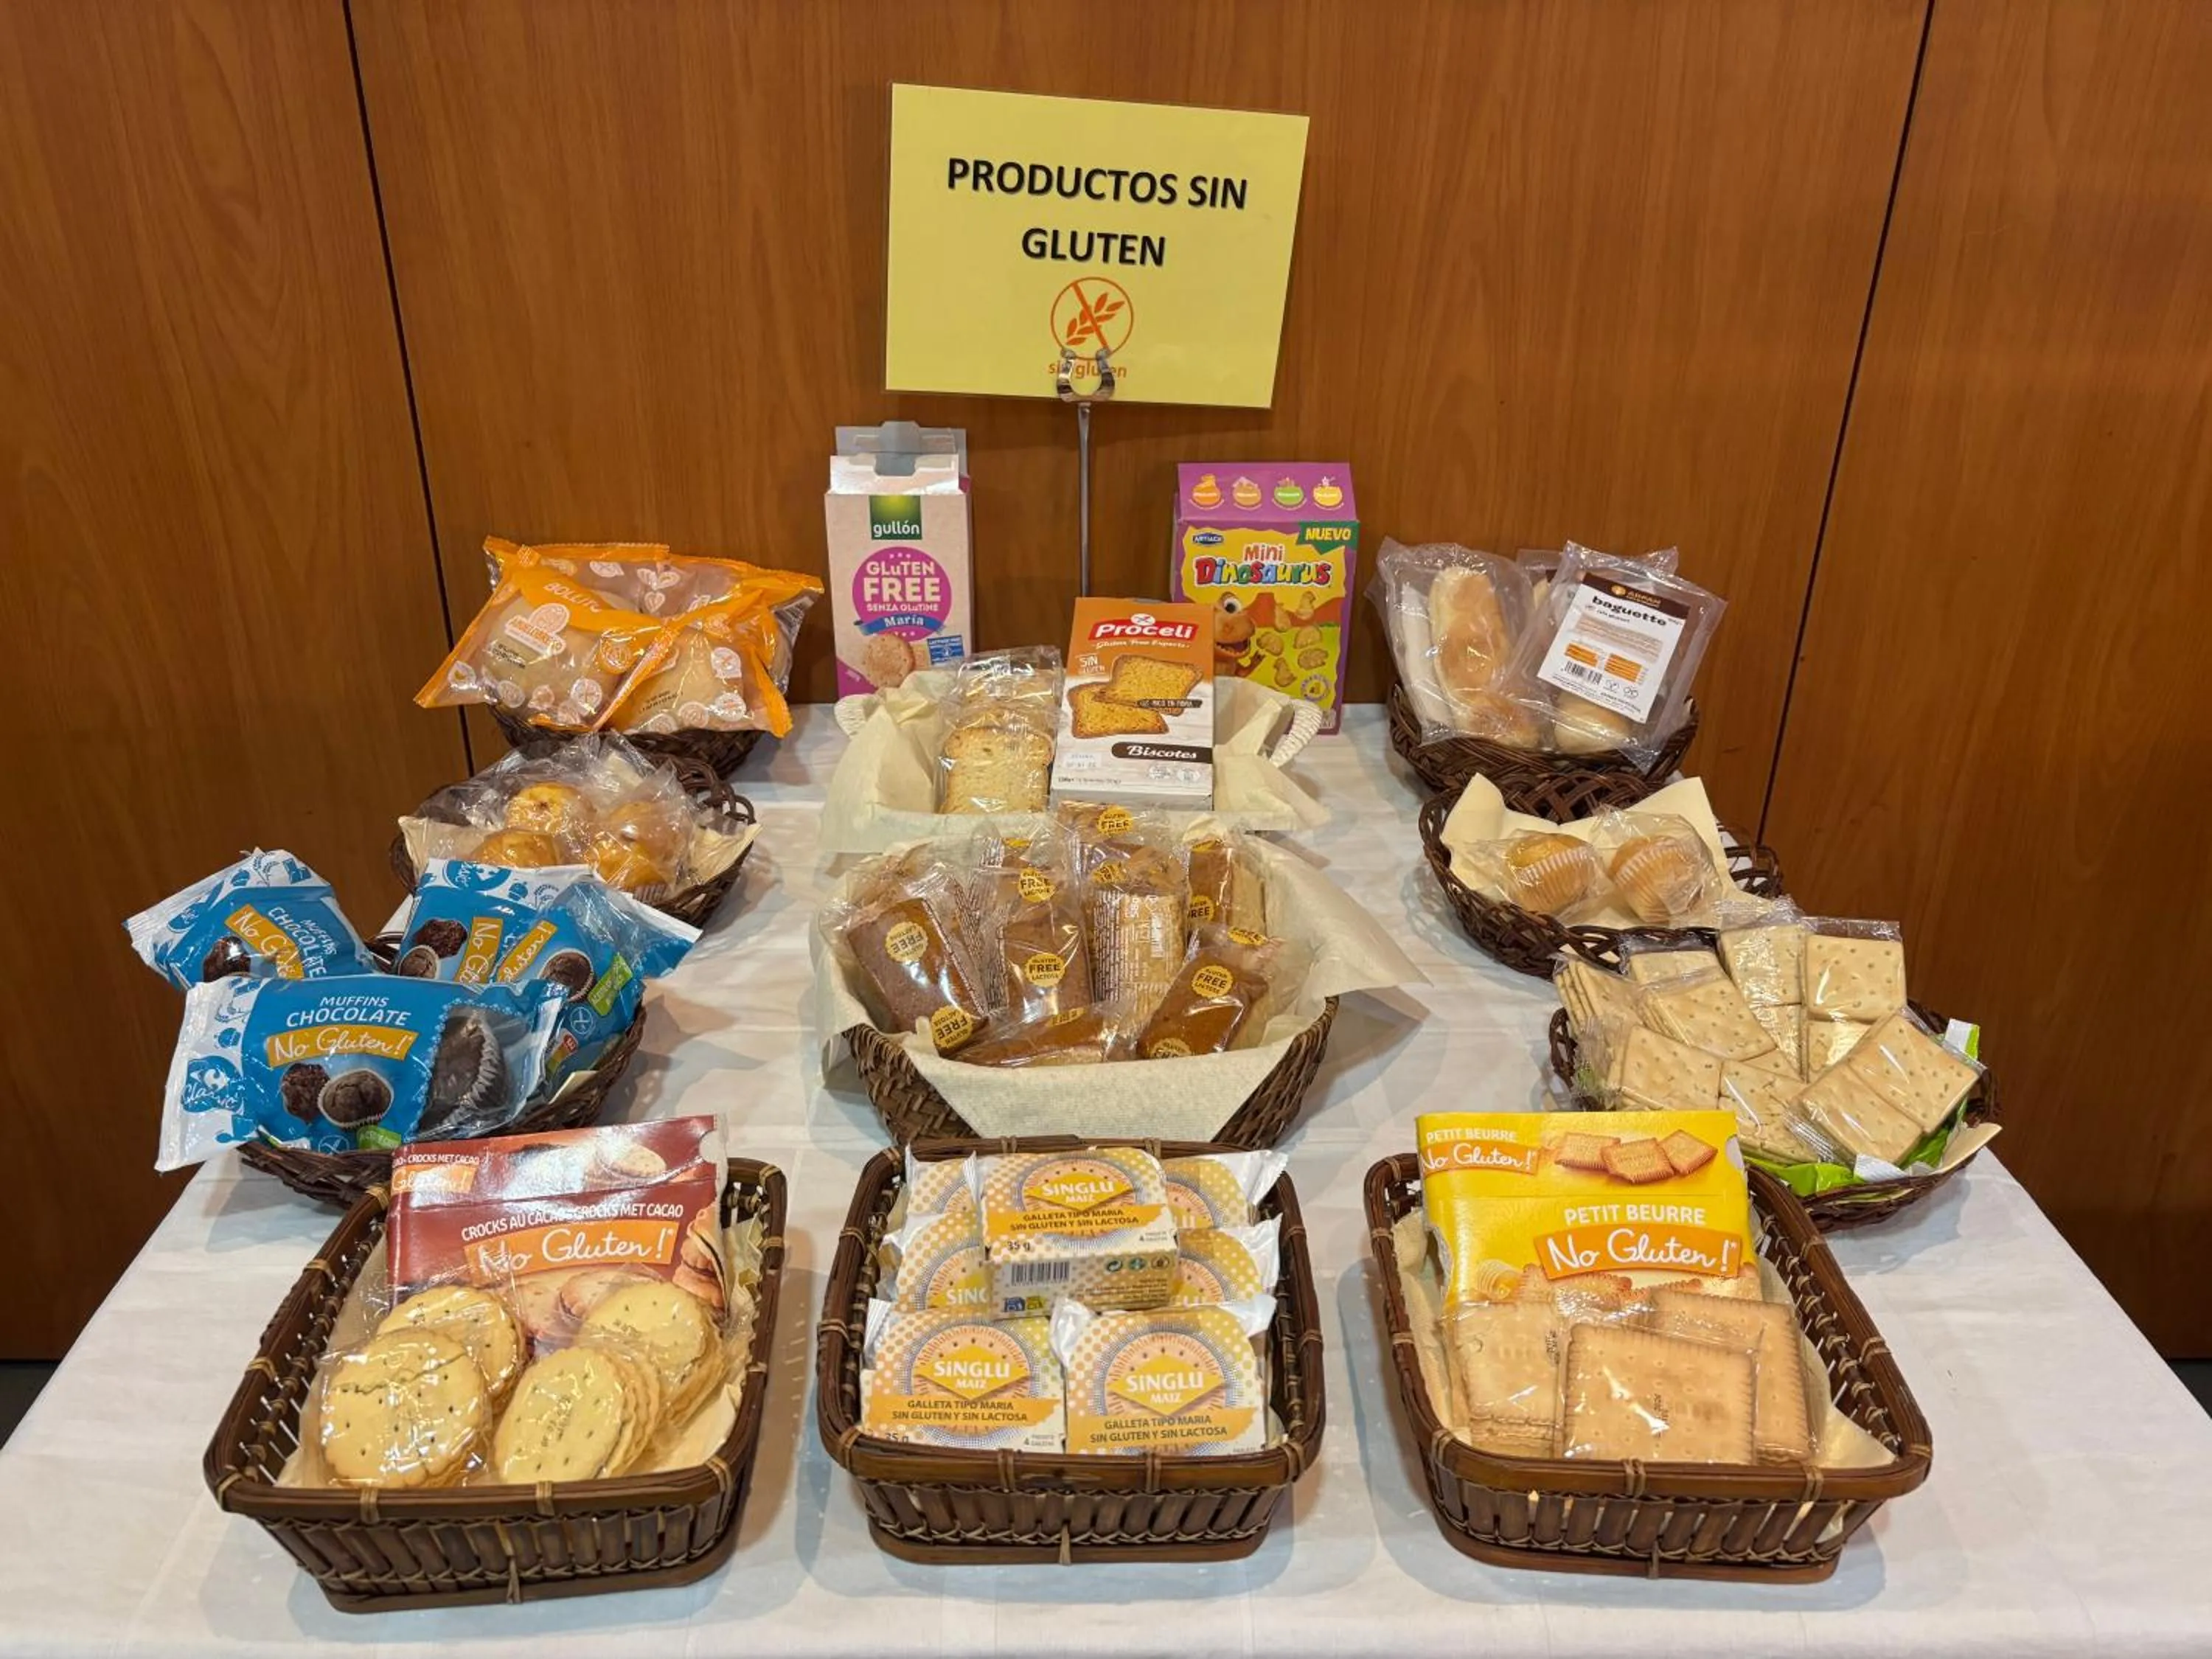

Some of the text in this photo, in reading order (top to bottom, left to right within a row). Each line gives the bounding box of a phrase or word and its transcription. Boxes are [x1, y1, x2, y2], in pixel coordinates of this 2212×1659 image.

[947, 158, 1248, 210] PRODUCTOS SIN
[1022, 228, 1166, 266] GLUTEN
[1075, 361, 1127, 379] gluen
[873, 520, 920, 538] gullón
[1306, 527, 1352, 541] NUEVO
[1244, 543, 1284, 560] Mini
[1195, 557, 1332, 586] Dinosaurus
[863, 577, 942, 602] FREE
[1095, 624, 1193, 639] Proceli
[1127, 745, 1197, 759] Biscotes
[1189, 907, 1211, 918] REE
[1029, 964, 1061, 973] FREE
[1196, 973, 1228, 989] FREE
[319, 996, 390, 1007] MUFFINS
[286, 1007, 411, 1027] CHOCOLATE
[935, 1015, 968, 1040] FREE
[275, 1034, 310, 1061] No
[1426, 1127, 1517, 1143] PETIT BEURRE
[407, 1154, 438, 1164] CROCKS
[438, 1153, 455, 1163] MET
[456, 1154, 479, 1164] CACAO
[461, 1218, 509, 1242] CROCKS
[509, 1214, 527, 1229] AU
[573, 1204, 619, 1220] CROCKS
[620, 1203, 646, 1217] MET
[647, 1203, 684, 1217] CACAO
[1023, 1211, 1067, 1222] GALLETA
[1068, 1210, 1091, 1220] TIPO
[1564, 1204, 1706, 1225] PETIT BEURRE
[1010, 1216, 1139, 1231] SIN GLUTEN Y SIN LACTOSA
[1547, 1235, 1600, 1272] No
[956, 1378, 987, 1389] MAIZ
[908, 1400, 1014, 1411] GALLETA TIPO MARIA
[1150, 1393, 1182, 1405] MAIZ
[891, 1411, 1029, 1422] SIN GLUTEN Y SIN LACTOSA
[1104, 1414, 1213, 1430] GALLETA TIPO MARIA
[1090, 1426, 1228, 1444] SIN GLUTEN Y SIN LACTOSA
